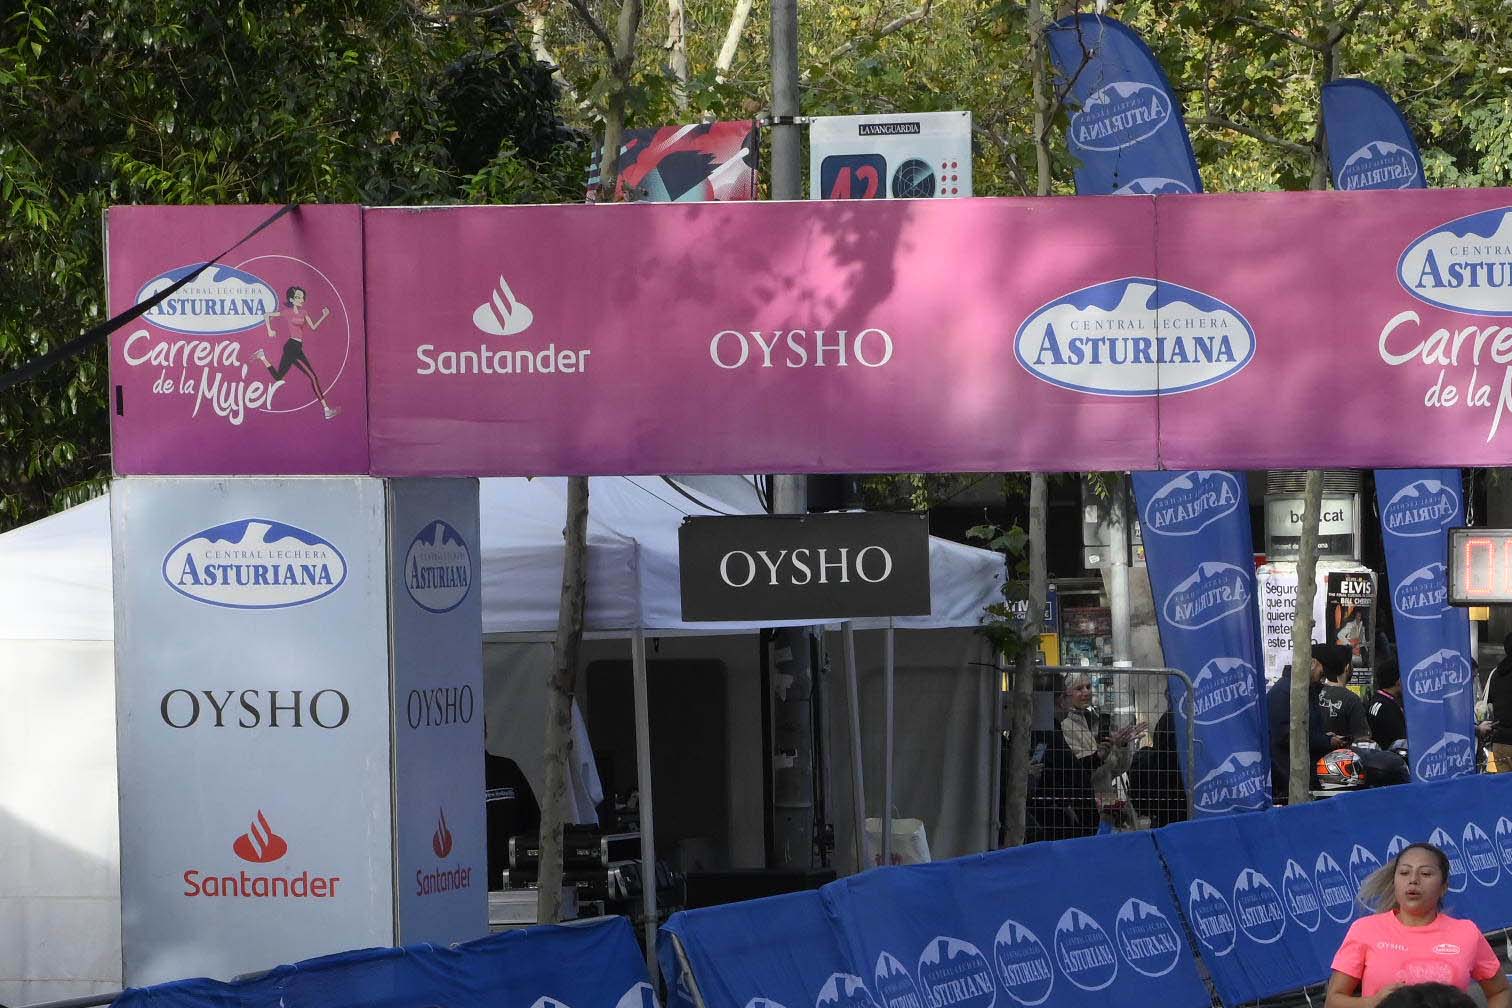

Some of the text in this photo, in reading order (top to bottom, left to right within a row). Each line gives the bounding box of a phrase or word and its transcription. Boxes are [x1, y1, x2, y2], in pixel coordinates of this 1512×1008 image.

[869, 123, 918, 134] VANGUARDIA
[216, 287, 263, 295] LECHERA
[1070, 317, 1229, 331] CENTRAL LECHERA
[123, 329, 241, 367] Carrera
[416, 342, 591, 374] Santander
[709, 328, 894, 368] OYSHO
[1034, 322, 1237, 367] ASTURIANA
[153, 364, 285, 426] de la Mujer
[1424, 369, 1458, 407] de
[1467, 368, 1490, 407] la
[177, 552, 334, 586] ASTURIANA
[205, 550, 327, 560] CENTRAL LECHERA
[719, 545, 893, 588] OYSHO
[410, 556, 468, 590] ASTURIANA
[1341, 581, 1371, 594] ELVIS
[1266, 598, 1283, 609] que
[1266, 609, 1295, 622] quiere
[1267, 638, 1286, 648] este
[160, 689, 350, 729] OYSHO
[407, 684, 474, 730] OYSHO
[183, 869, 340, 898] Santander
[416, 865, 472, 896] Santander
